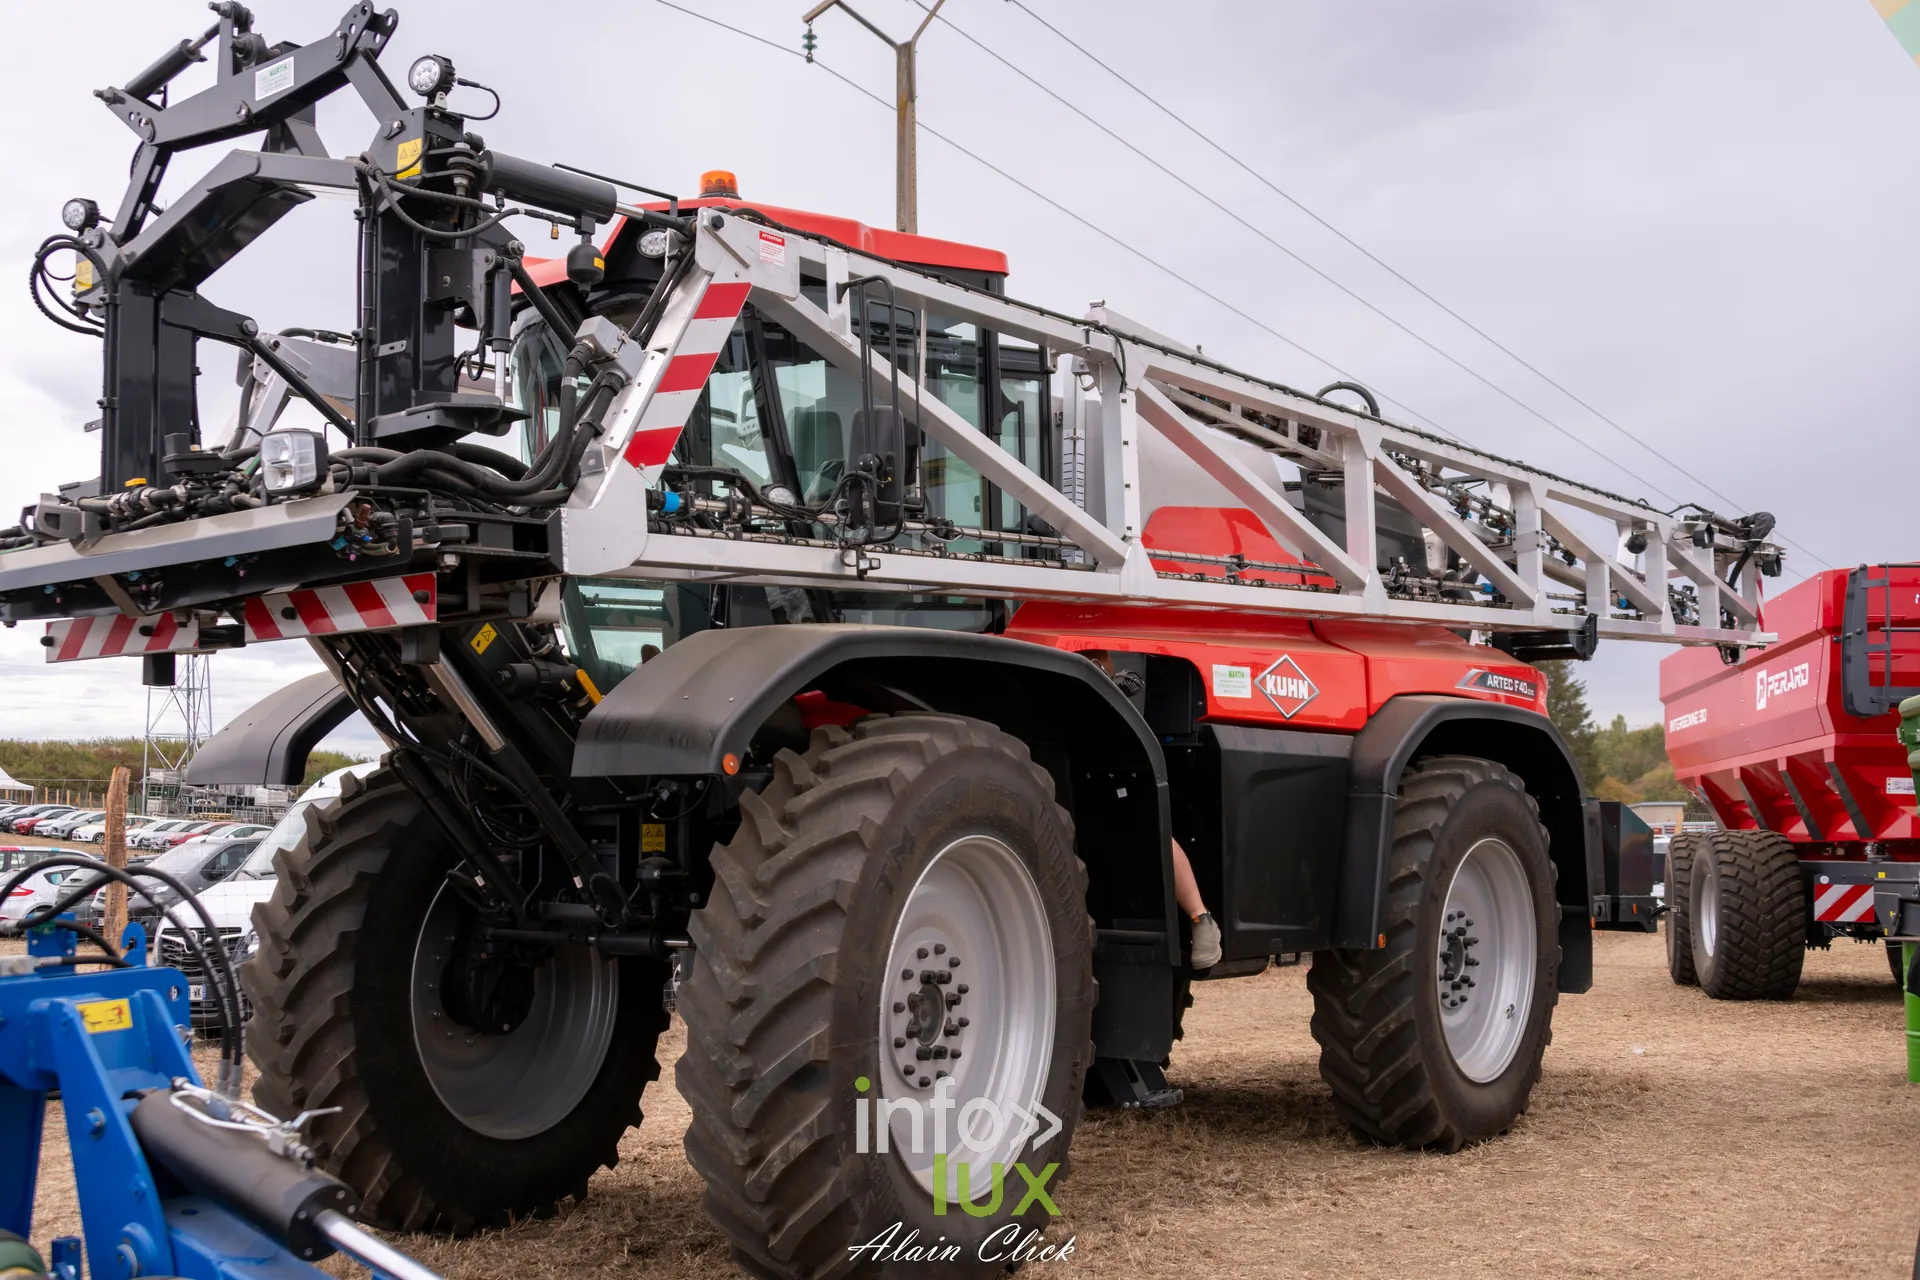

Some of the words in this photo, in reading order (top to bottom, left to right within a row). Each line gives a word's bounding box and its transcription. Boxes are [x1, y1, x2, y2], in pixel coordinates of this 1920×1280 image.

[1266, 674, 1309, 700] KUHN
[1487, 674, 1514, 691] ARTEC
[1767, 662, 1809, 697] PERARD
